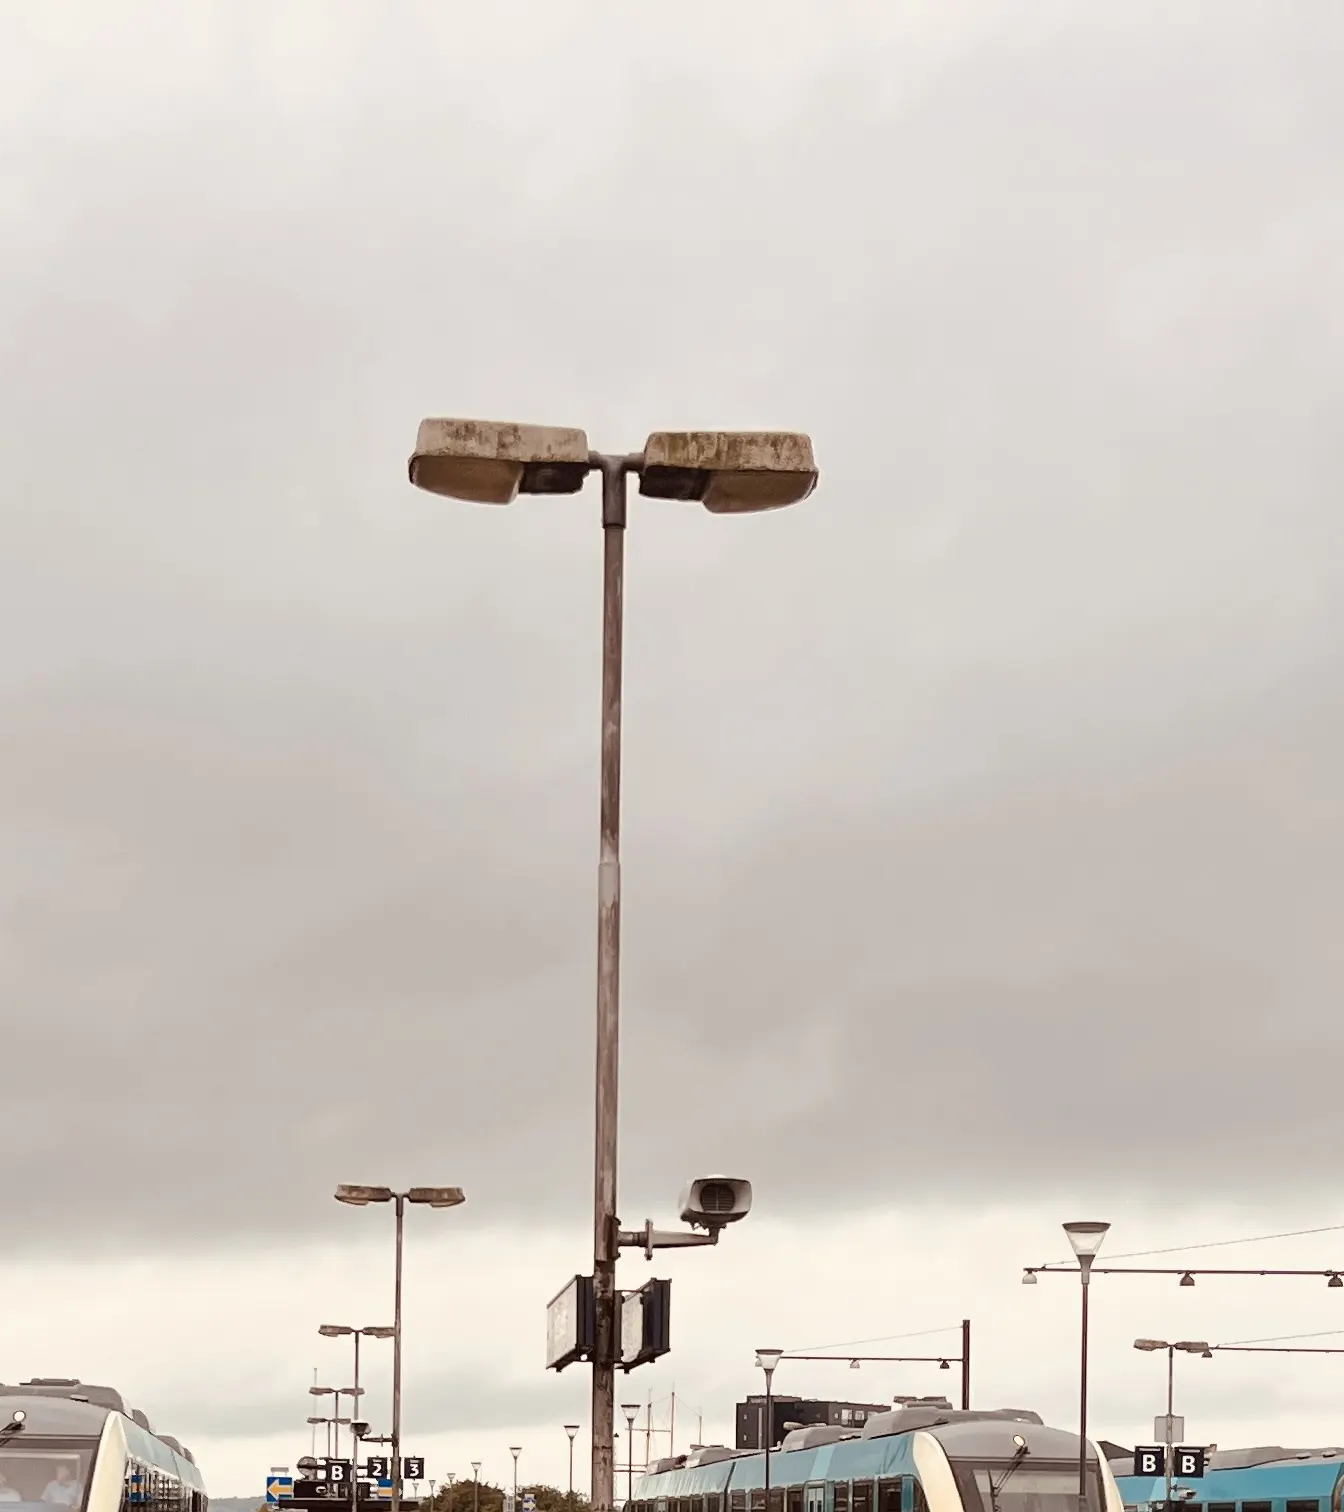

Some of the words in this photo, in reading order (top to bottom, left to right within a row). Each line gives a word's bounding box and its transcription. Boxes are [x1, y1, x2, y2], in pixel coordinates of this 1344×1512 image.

[373, 1464, 382, 1477] 2
[410, 1464, 419, 1477] 3
[1142, 1454, 1156, 1472] B
[1181, 1455, 1196, 1473] B
[331, 1465, 344, 1481] B
